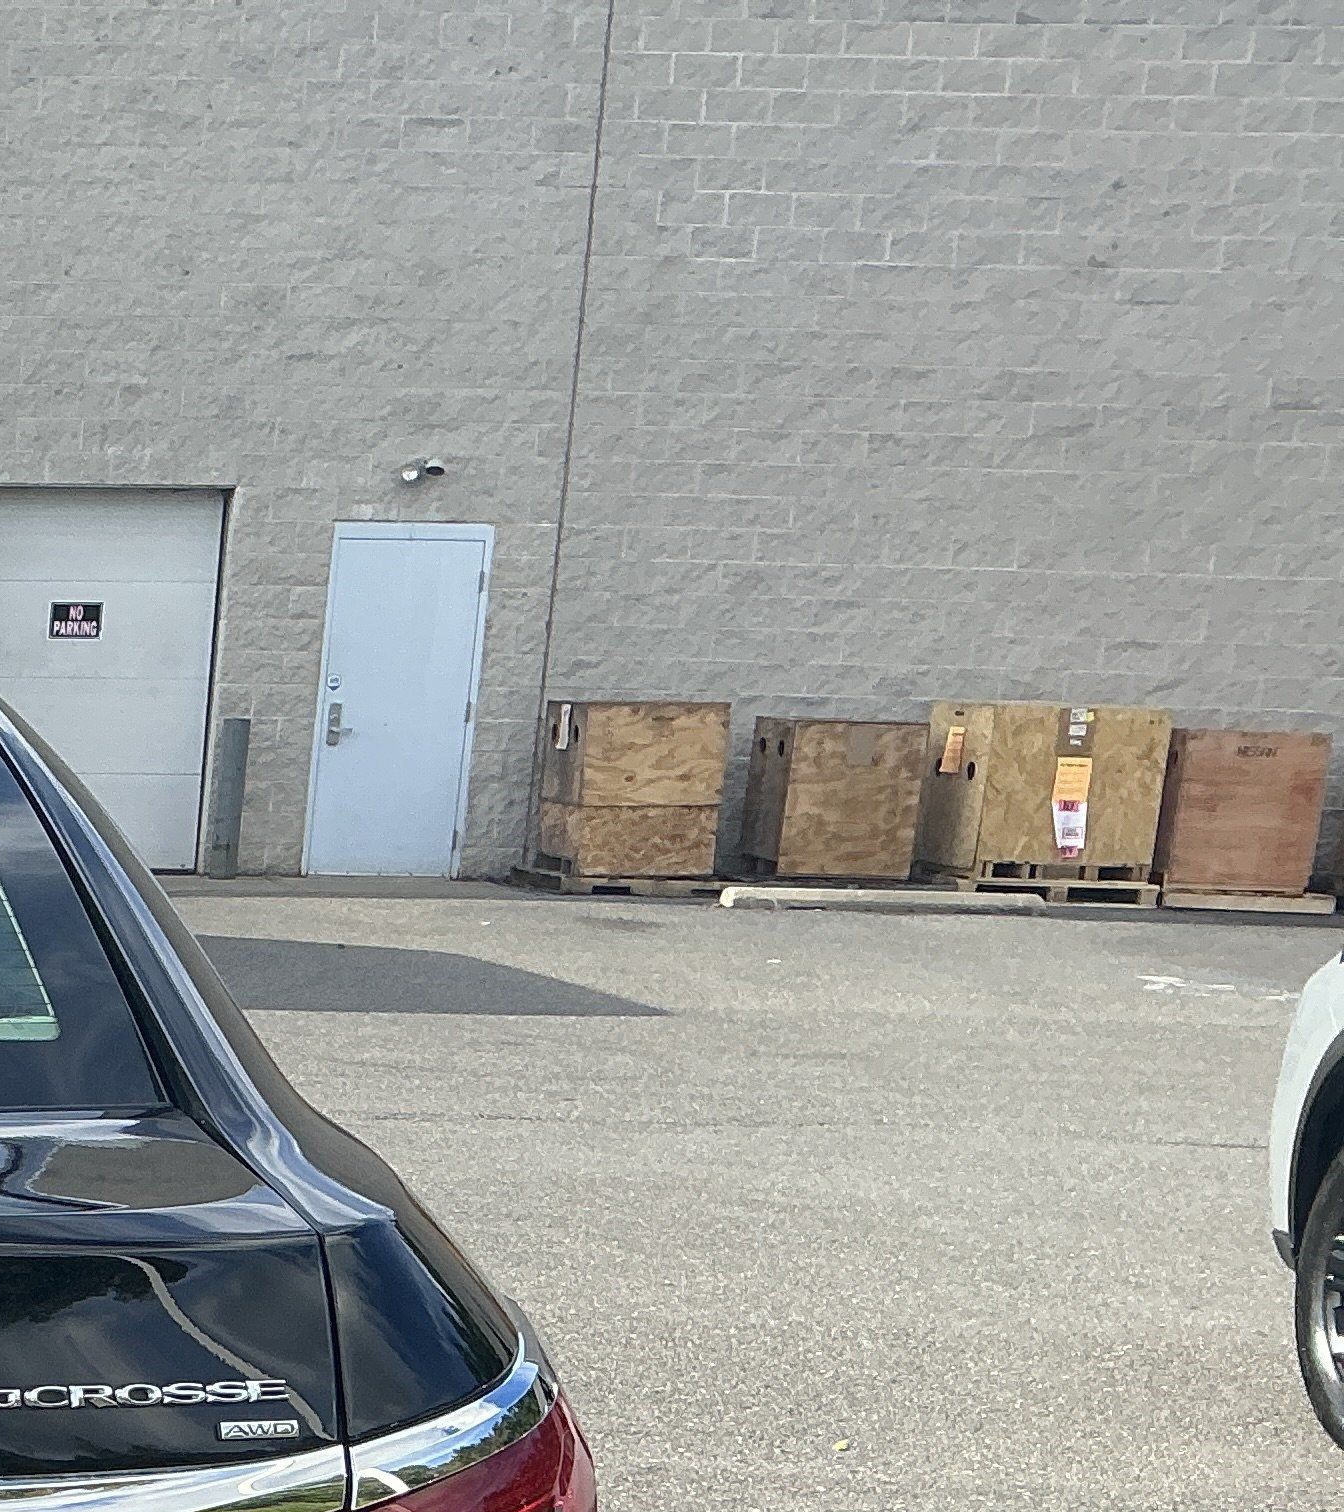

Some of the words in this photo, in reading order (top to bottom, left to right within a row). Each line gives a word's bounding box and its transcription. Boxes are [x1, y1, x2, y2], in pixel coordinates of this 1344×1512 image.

[69, 605, 84, 620] NO
[53, 620, 97, 636] PARKING
[224, 1421, 297, 1439] AWD
